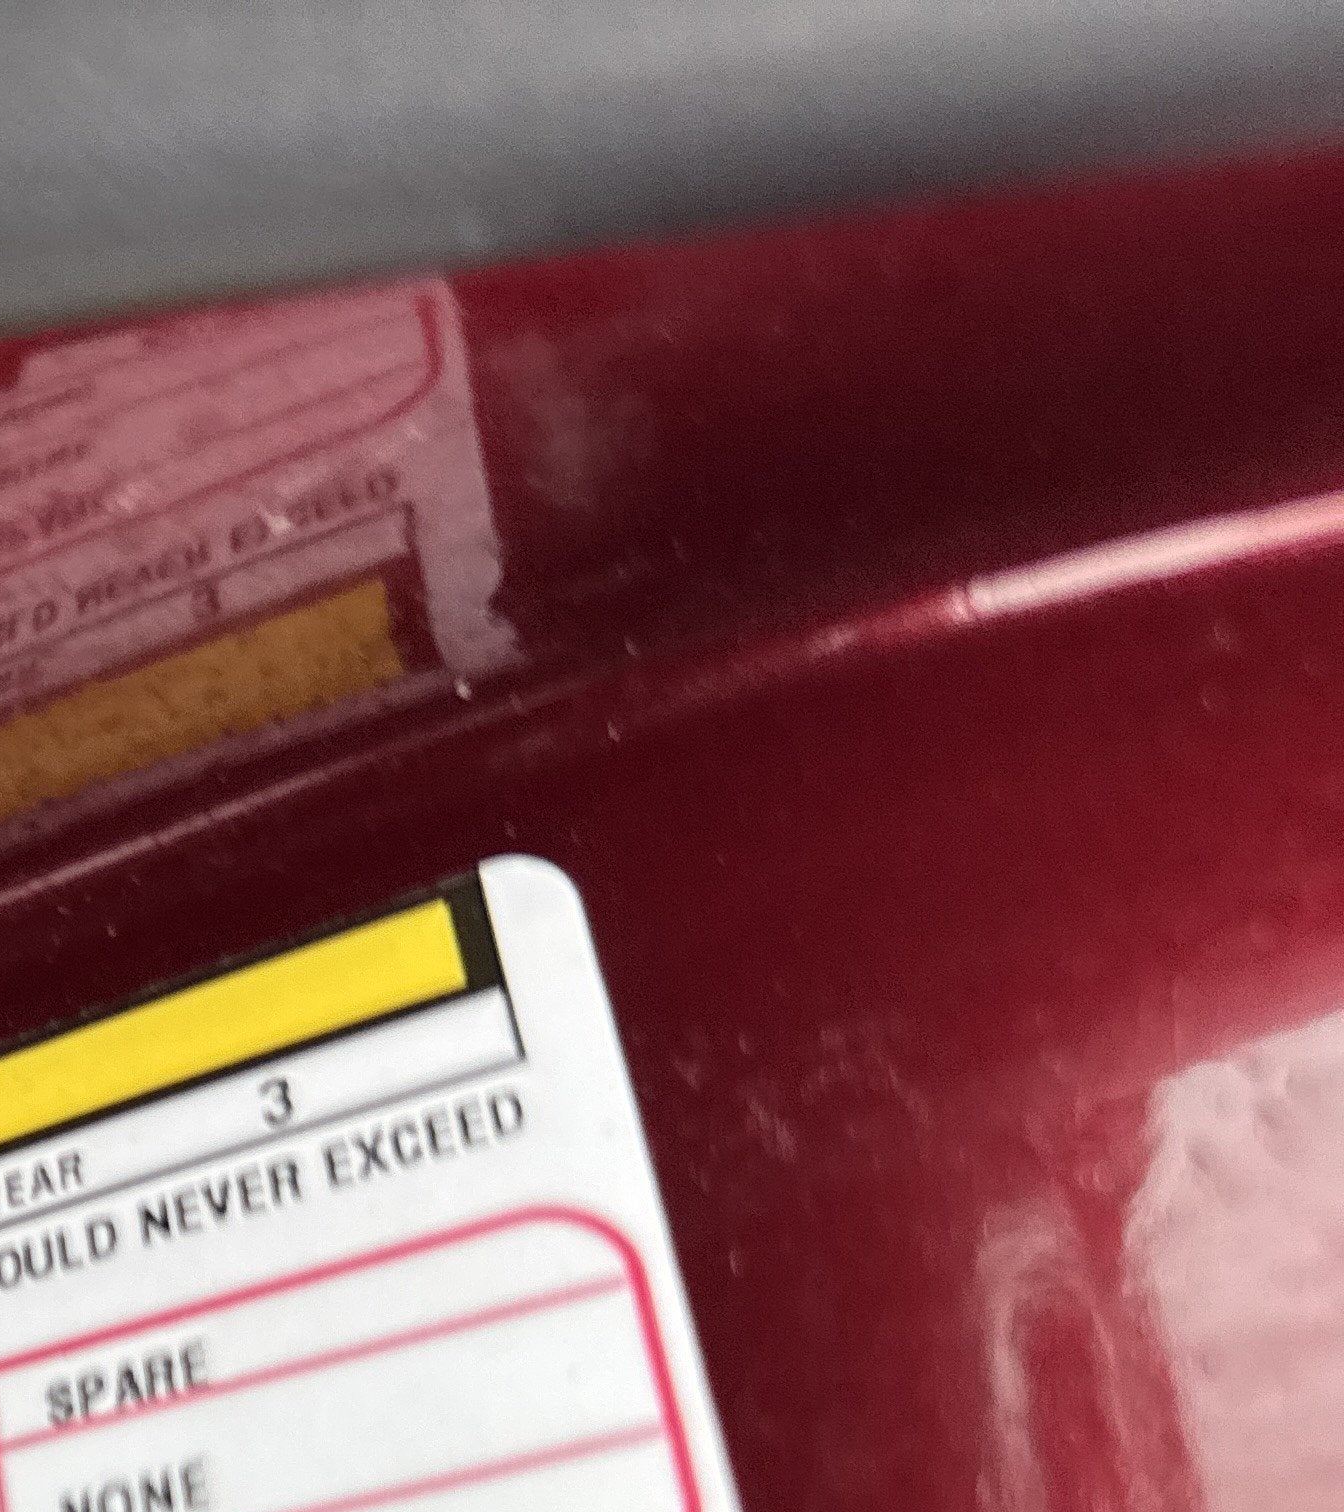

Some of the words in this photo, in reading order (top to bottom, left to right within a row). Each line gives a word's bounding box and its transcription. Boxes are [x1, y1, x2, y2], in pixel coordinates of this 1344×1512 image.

[261, 1076, 293, 1129] 3
[138, 1156, 303, 1245] NEVER
[322, 1087, 527, 1189] EXCEED
[44, 1337, 211, 1430] SPARE
